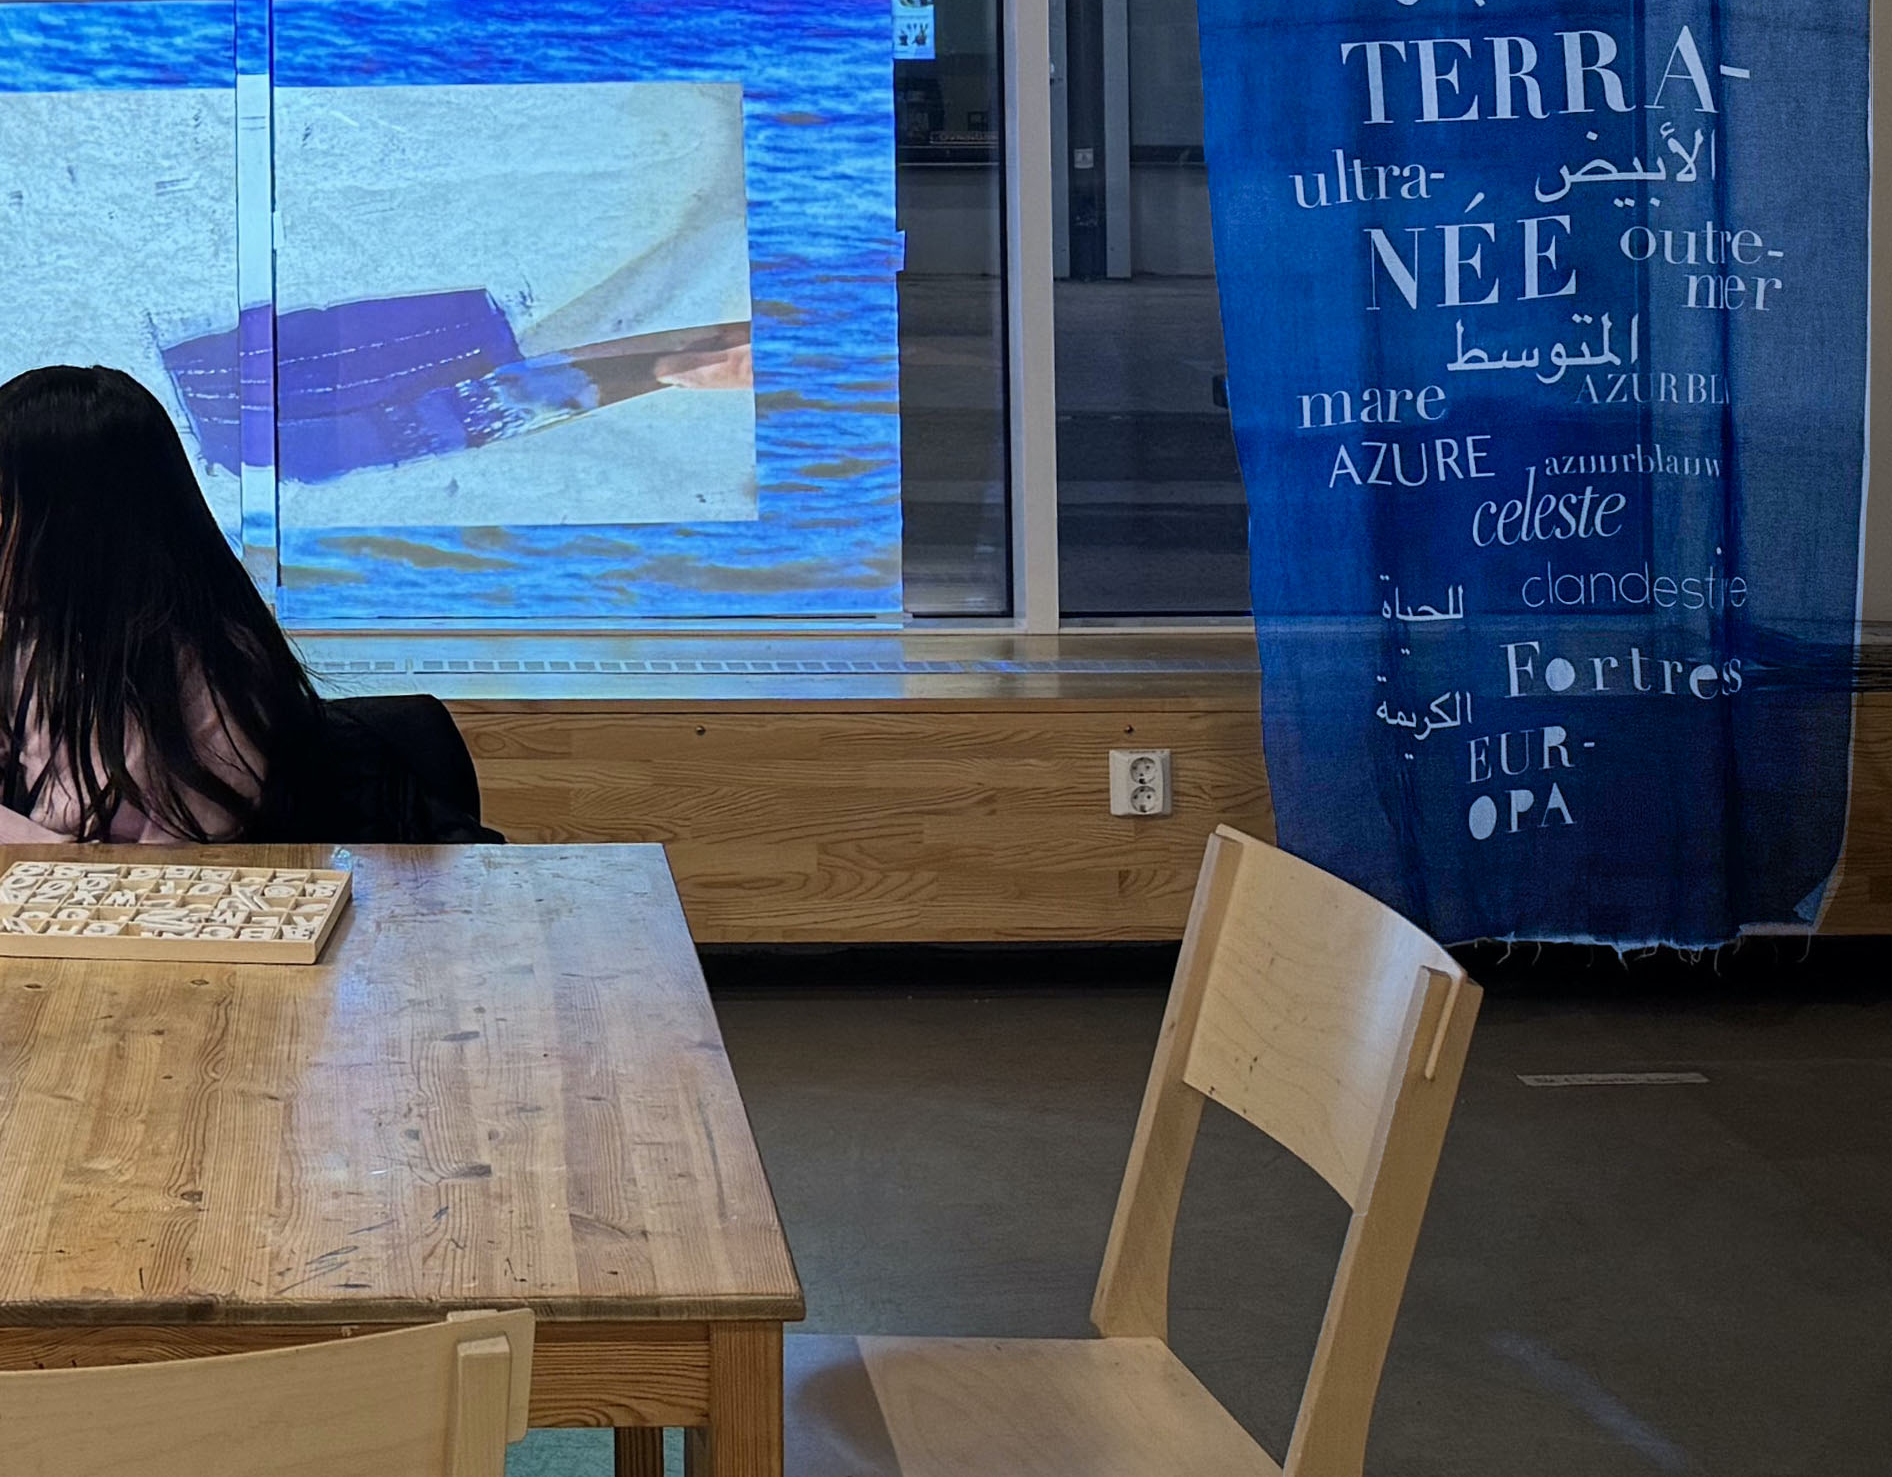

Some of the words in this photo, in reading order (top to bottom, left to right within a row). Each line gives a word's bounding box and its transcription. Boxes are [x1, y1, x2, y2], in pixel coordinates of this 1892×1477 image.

[1340, 25, 1751, 125] TERRA-
[1287, 148, 1445, 209] ultra-
[1363, 191, 1578, 311] NÉE
[1446, 311, 1640, 384] المتوسط
[1296, 382, 1447, 430] mare
[1328, 434, 1497, 489] AZURE
[1471, 466, 1627, 547] celeste
[1466, 725, 1597, 785] EUR-
[1467, 781, 1577, 842] OPA
